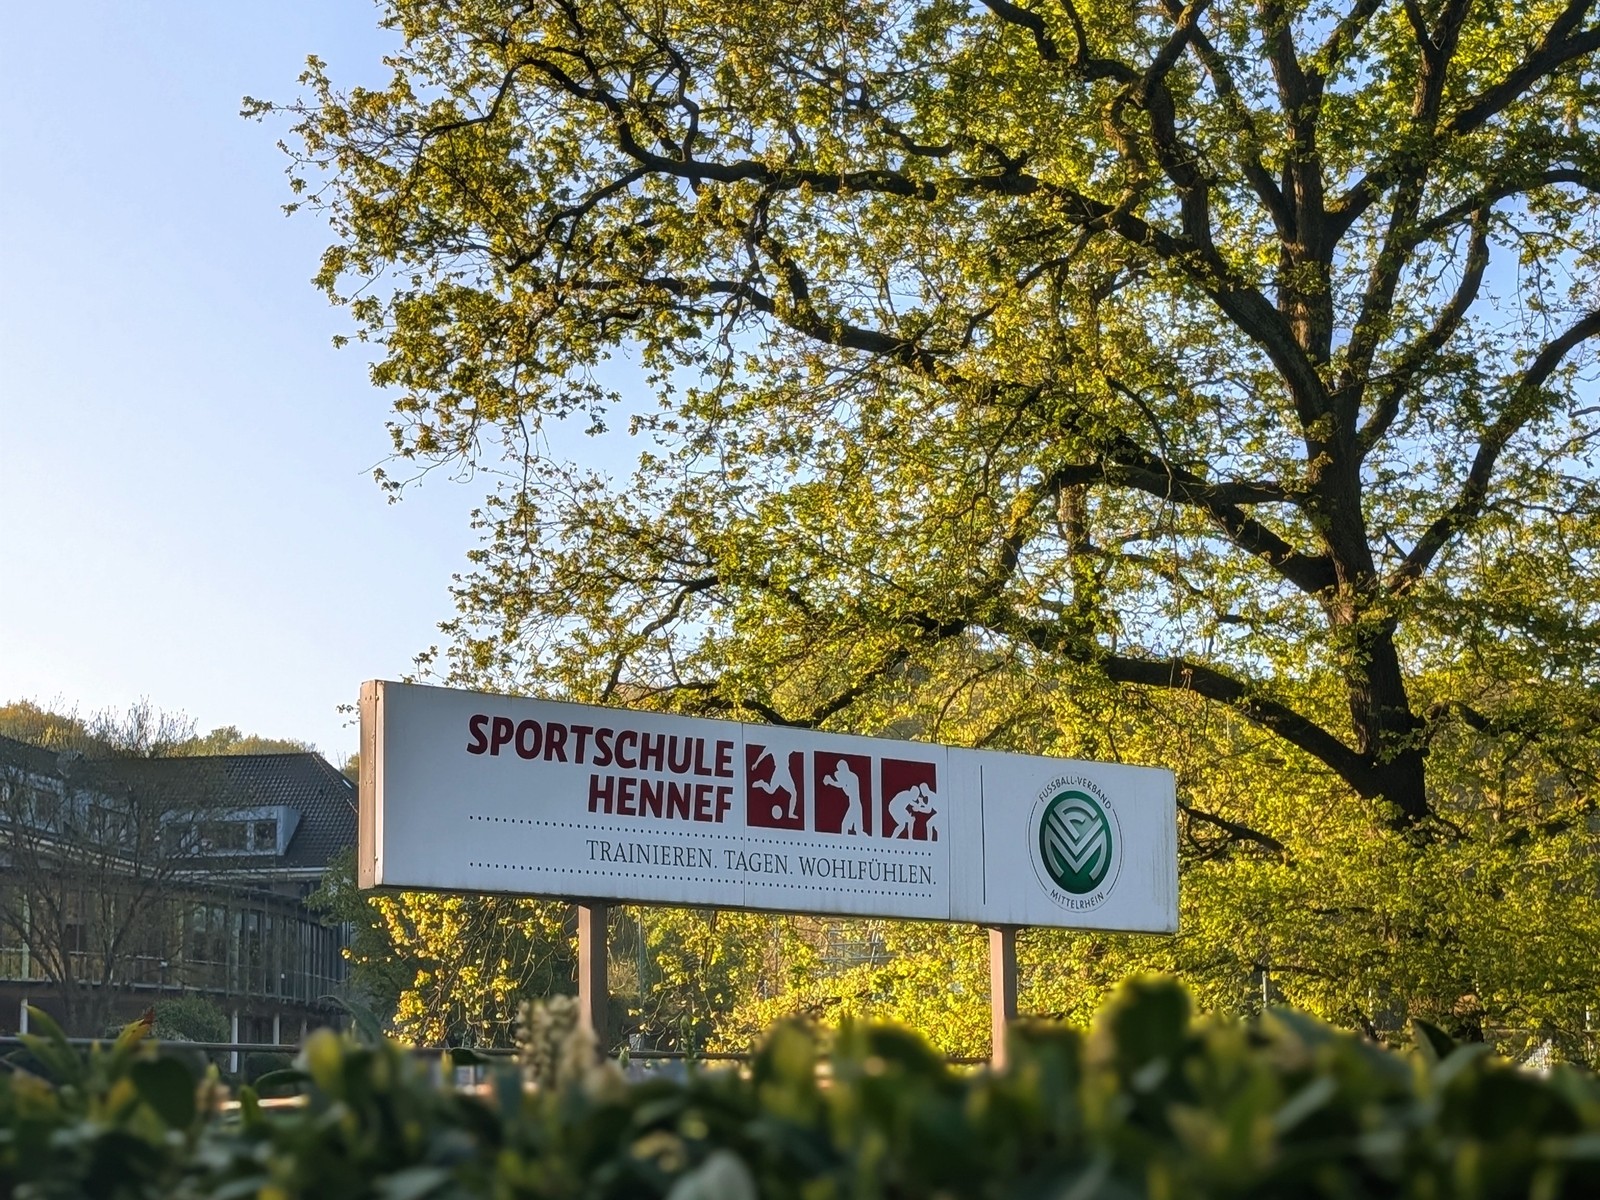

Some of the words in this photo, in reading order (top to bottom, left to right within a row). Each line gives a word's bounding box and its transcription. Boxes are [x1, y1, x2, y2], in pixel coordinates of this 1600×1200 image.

[466, 714, 734, 778] SPORTSCHULE
[588, 774, 734, 823] HENNEF
[1038, 775, 1112, 810] FUSSBALL-VERBAND
[585, 839, 718, 869] TRAINIEREN.
[723, 849, 793, 875] TAGEN.
[798, 856, 937, 885] WOHLFÜHLEN.
[1050, 888, 1105, 910] MITTELRHEIN
